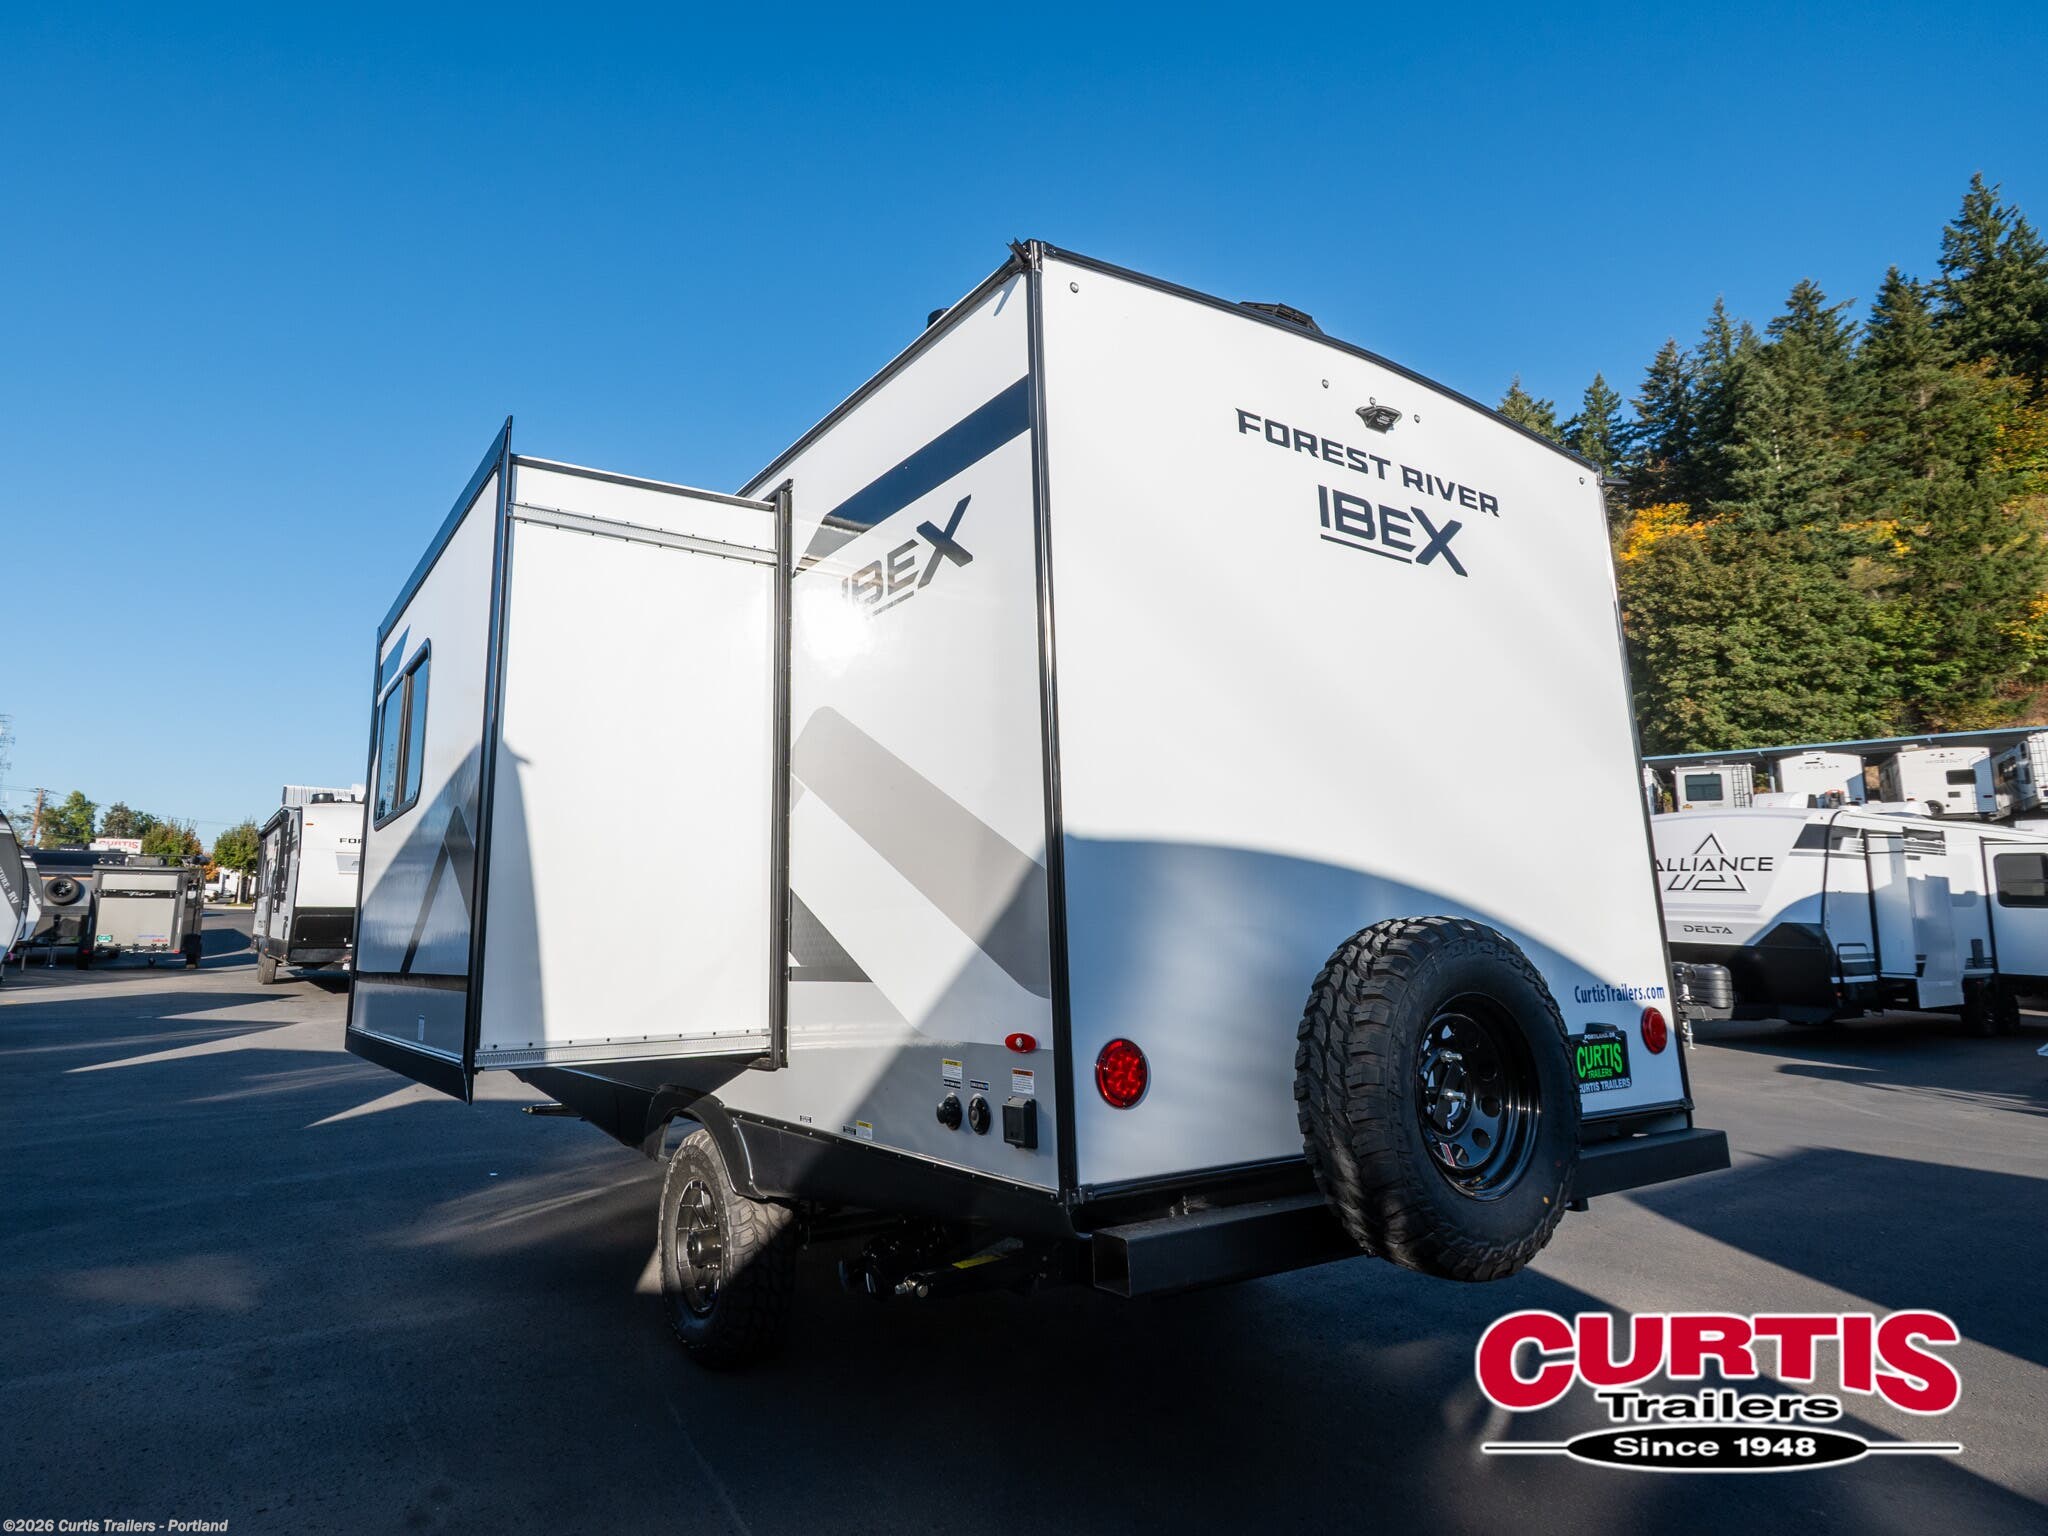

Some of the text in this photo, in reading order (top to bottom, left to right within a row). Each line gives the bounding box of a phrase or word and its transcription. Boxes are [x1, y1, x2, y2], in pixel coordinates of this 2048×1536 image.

[1235, 408, 1500, 518] FOREST RIVER
[1317, 484, 1469, 578] IBEX
[1656, 856, 1774, 872] ALLIANCE
[1683, 924, 1734, 935] DELTA
[1575, 984, 1665, 1004] CurtisTrailers.com
[1576, 1043, 1623, 1078] CURTIS
[1587, 1067, 1613, 1079] TRAILERS
[1601, 1079, 1631, 1090] TRAILERS
